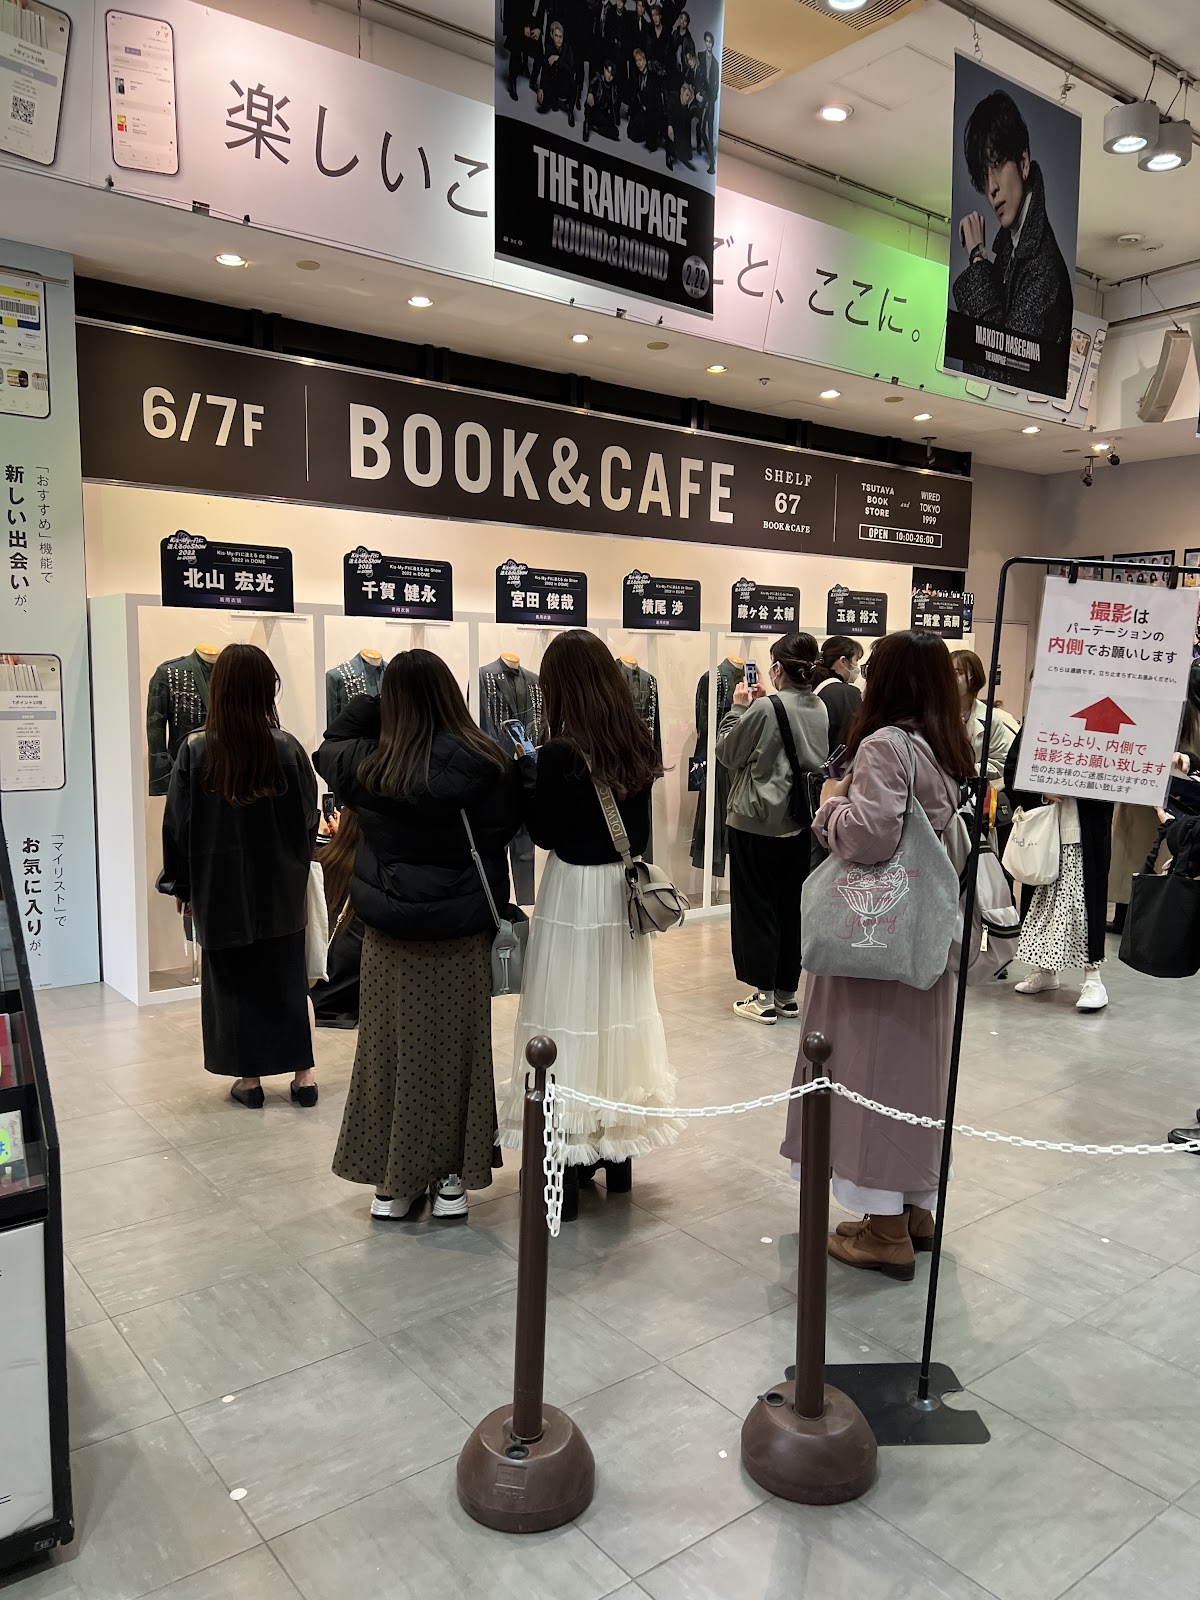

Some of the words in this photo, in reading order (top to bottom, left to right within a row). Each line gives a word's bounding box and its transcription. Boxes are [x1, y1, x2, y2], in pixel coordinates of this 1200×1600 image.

[532, 144, 579, 210] THE
[583, 162, 689, 247] RAMPAGE
[551, 213, 670, 282] ROUND&ROUND
[685, 264, 706, 290] 2.22
[975, 324, 1005, 352] MAKOTO
[1005, 332, 1041, 362] HASEGAWA
[141, 386, 265, 448] 6/7F
[349, 402, 735, 524] BOOK&CAFE
[764, 467, 813, 487] SHELF
[861, 482, 895, 496] TSUTAYA
[866, 495, 889, 506] BOOK
[920, 490, 941, 502] WIRED
[774, 492, 801, 515] 67
[864, 506, 890, 518] STORE
[919, 502, 941, 514] TOKYO
[35, 466, 54, 584] 「おすすめ」機能で
[763, 520, 811, 534] BOOK&CAFE
[922, 514, 937, 525] 1999
[4, 464, 30, 613] 新しい出会いが、
[868, 527, 889, 540] OPEN
[895, 530, 935, 545] 10:00-26:00
[183, 567, 225, 590] 北山
[234, 571, 275, 593] 宏光
[361, 580, 396, 600] 千賀
[404, 582, 437, 603] 健永
[510, 590, 540, 608] 宮田
[546, 592, 574, 610] 俊哉
[641, 598, 667, 615] 横尾
[836, 608, 856, 623] 玉森
[859, 609, 879, 624] 裕太
[914, 613, 941, 627] 二階堂
[1089, 600, 1150, 624] 撮影は
[1066, 622, 1165, 642] パーテーションの
[1048, 636, 1178, 664] 内側でお願いします
[1036, 730, 1148, 756] こちらより、内側で
[1033, 746, 1167, 776] 撮影をお願い致します
[1029, 773, 1133, 794] ご協力よろしくお願い致します
[1031, 763, 1160, 788] 他のお客様のご迷惑になりますので、
[605, 803, 624, 838] LOEWE
[51, 833, 67, 927] 「マイリスト」で
[22, 837, 43, 957] お気に入りが、
